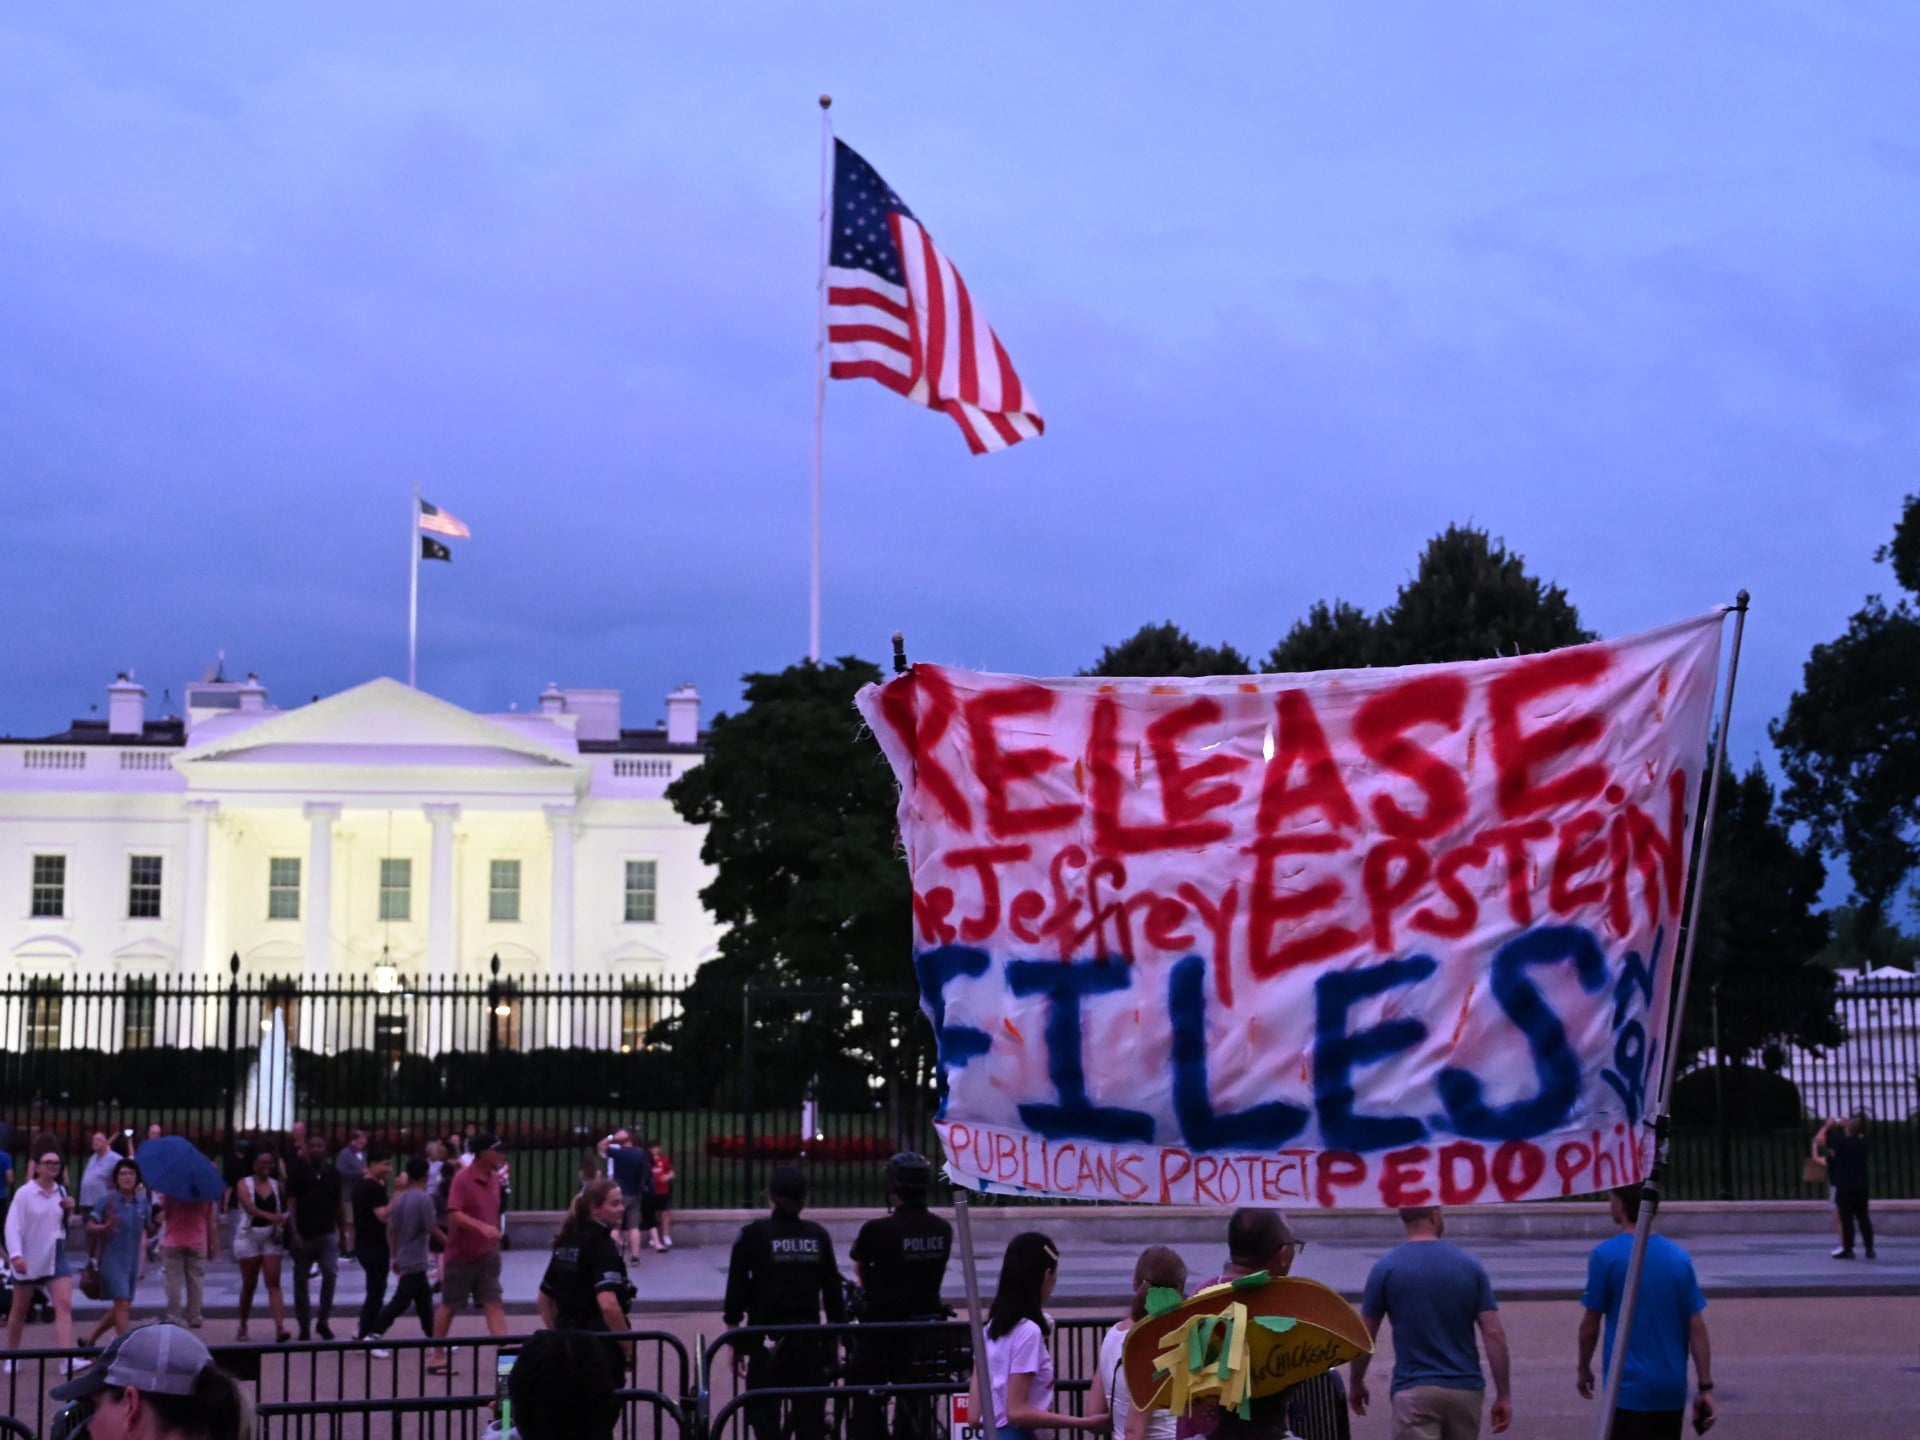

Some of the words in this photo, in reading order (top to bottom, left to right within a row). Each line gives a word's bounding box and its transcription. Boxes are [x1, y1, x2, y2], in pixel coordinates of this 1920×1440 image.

[882, 650, 1612, 855] RELEASE
[914, 924, 1606, 1152] FILES
[1159, 1147, 1315, 1204] PROTECT
[772, 1239, 819, 1253] POLICE
[903, 1236, 944, 1251] POLICE
